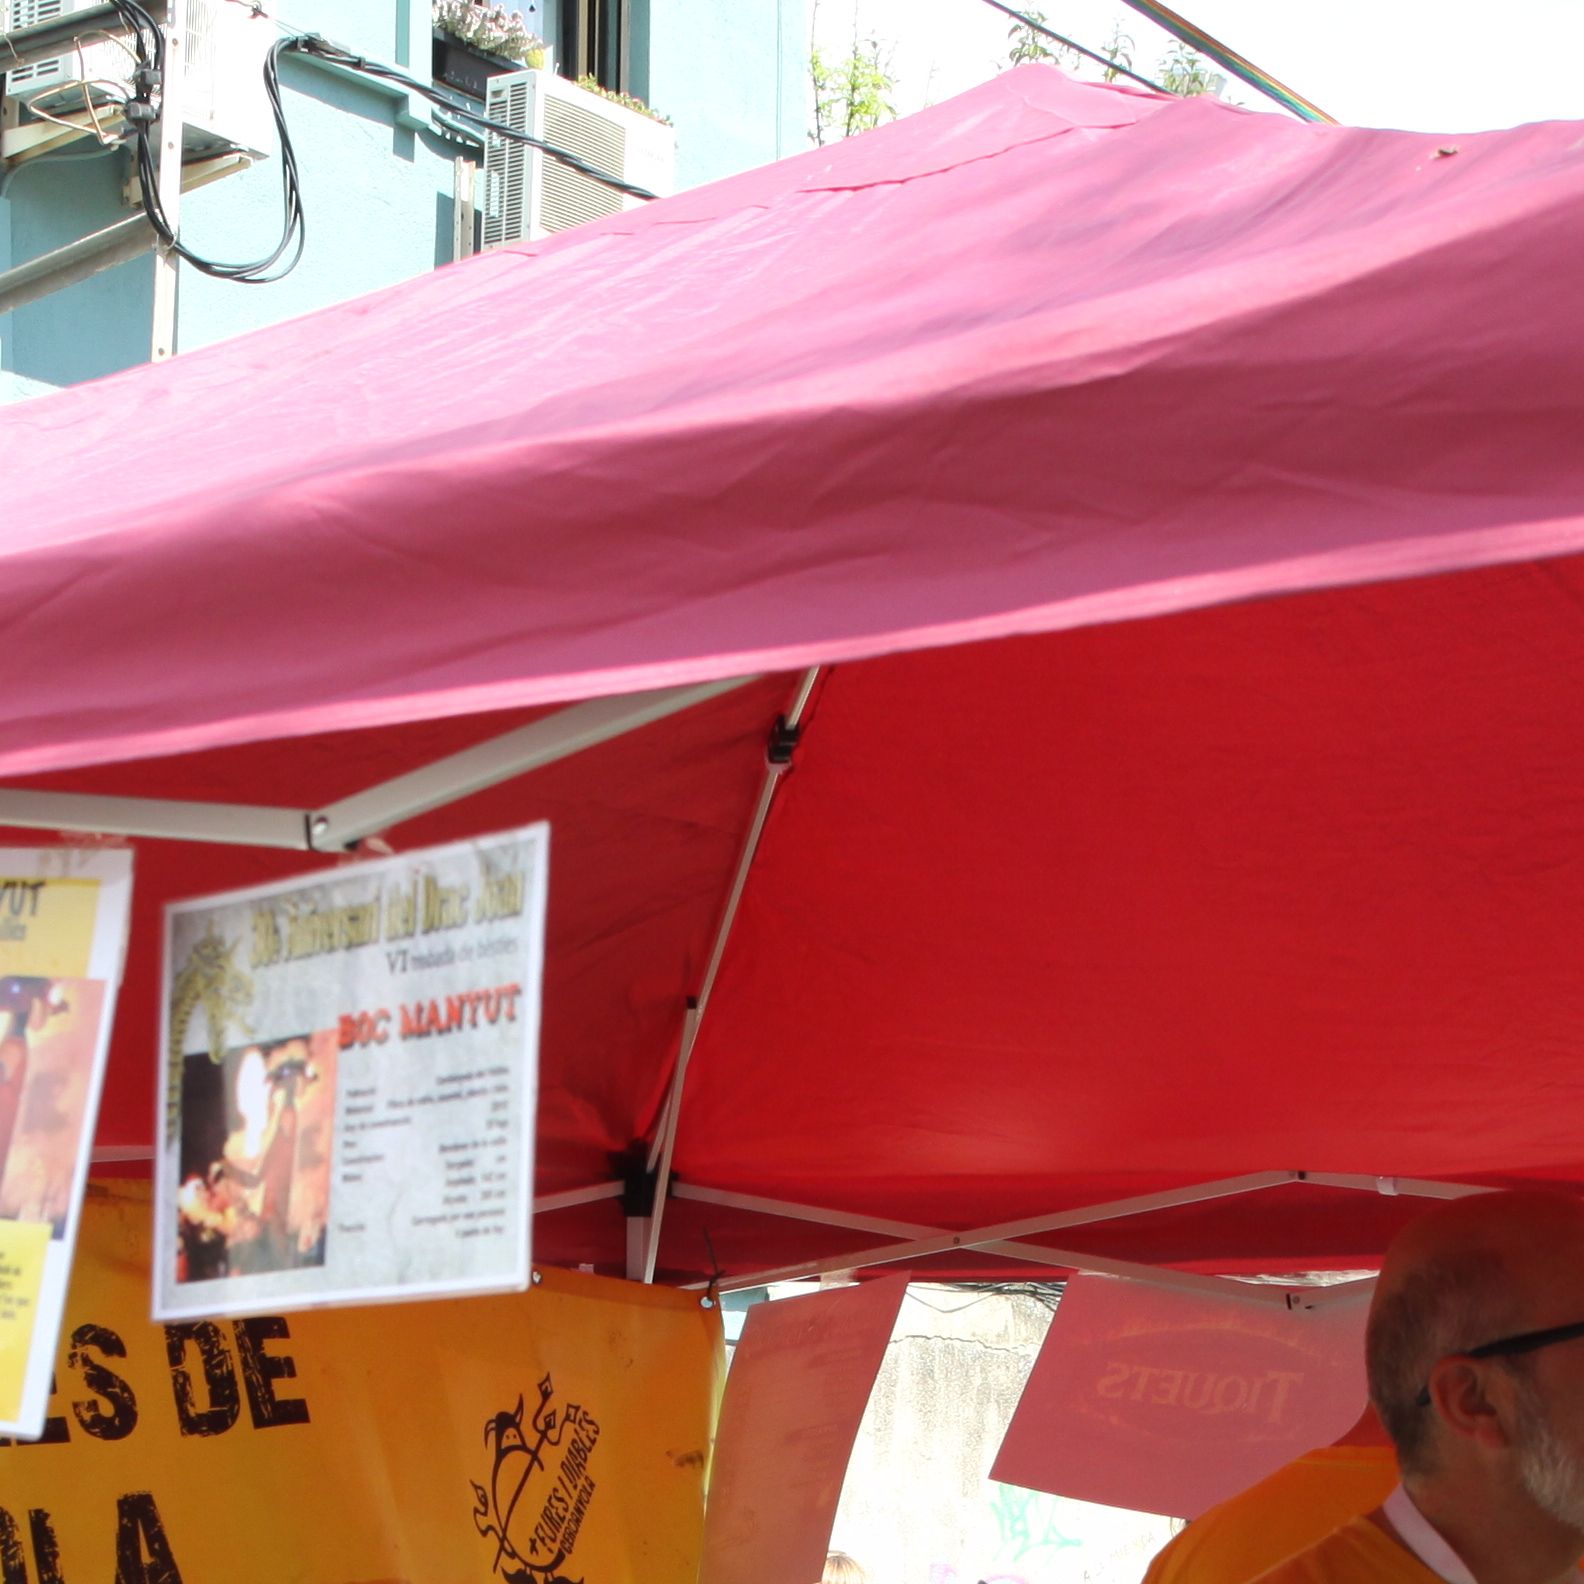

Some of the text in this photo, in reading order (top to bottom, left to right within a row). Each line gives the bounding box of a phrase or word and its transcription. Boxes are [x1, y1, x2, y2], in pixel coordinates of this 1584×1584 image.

[338, 981, 523, 1051] BOC MANYUT
[166, 1316, 311, 1440] DE
[561, 1409, 601, 1492] DIABLES
